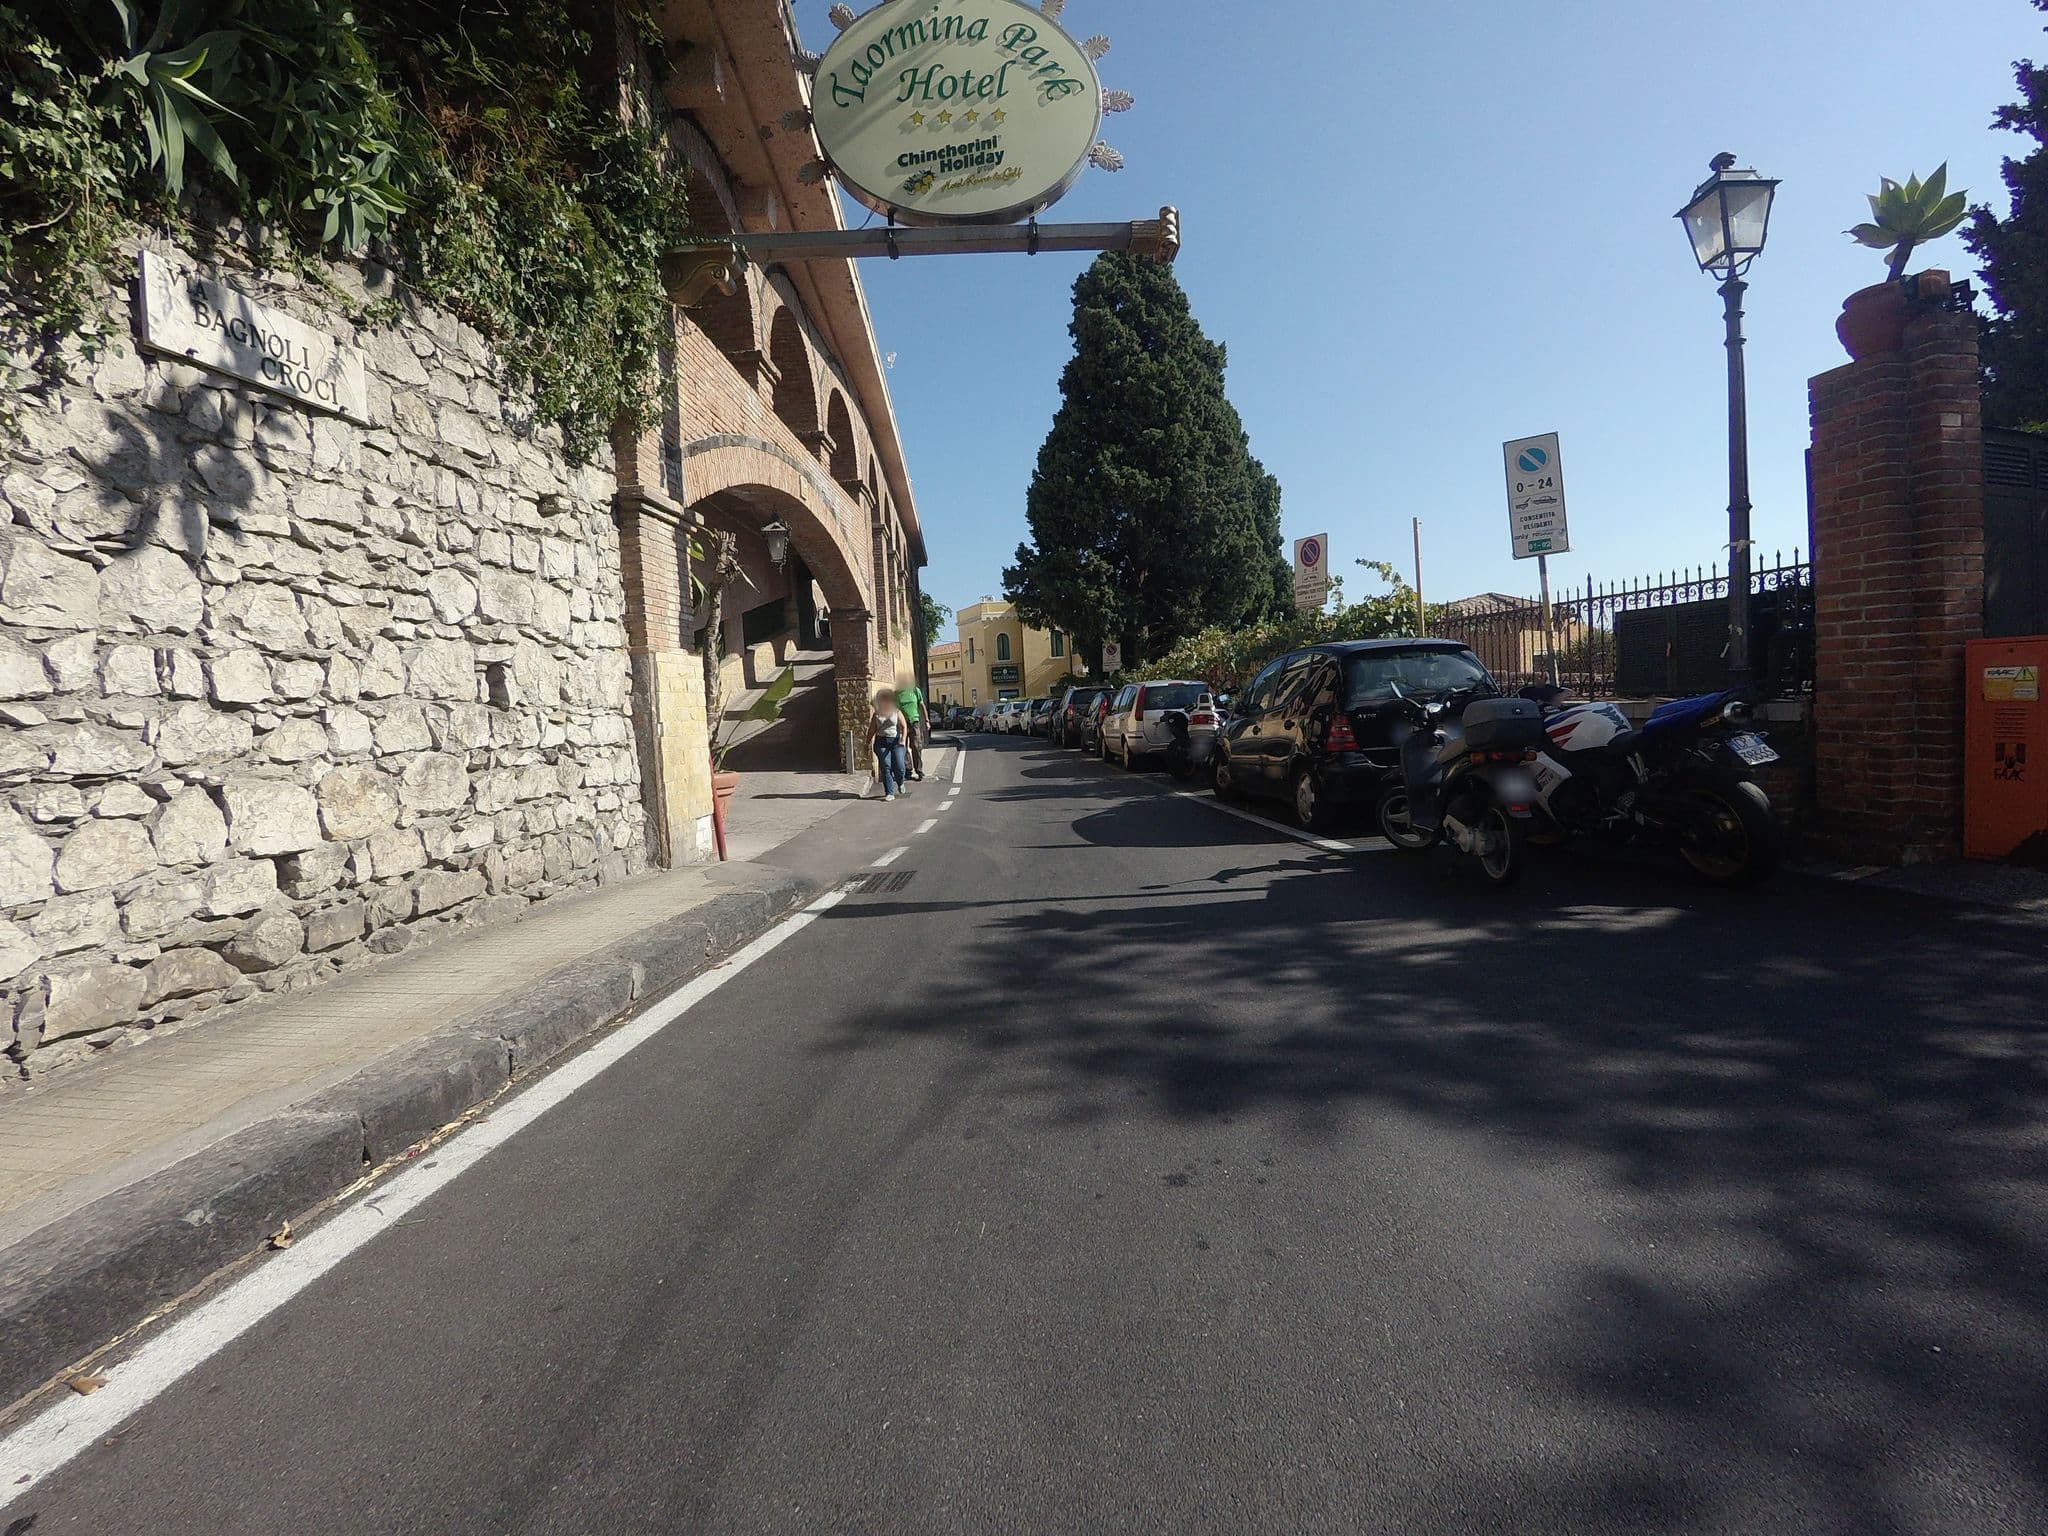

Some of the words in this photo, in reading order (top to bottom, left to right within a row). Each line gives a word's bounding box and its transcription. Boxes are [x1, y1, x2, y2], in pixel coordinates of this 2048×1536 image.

[831, 6, 990, 109] Taormina
[1002, 22, 1086, 103] Park
[896, 59, 1018, 103] Hotel
[897, 134, 1000, 168] Chincherini
[939, 150, 1005, 173] Holiday
[193, 303, 310, 371] BAGNOLI
[260, 356, 339, 405] CROCI
[1537, 476, 1553, 490] 24
[1994, 768, 2025, 782] FAAC
